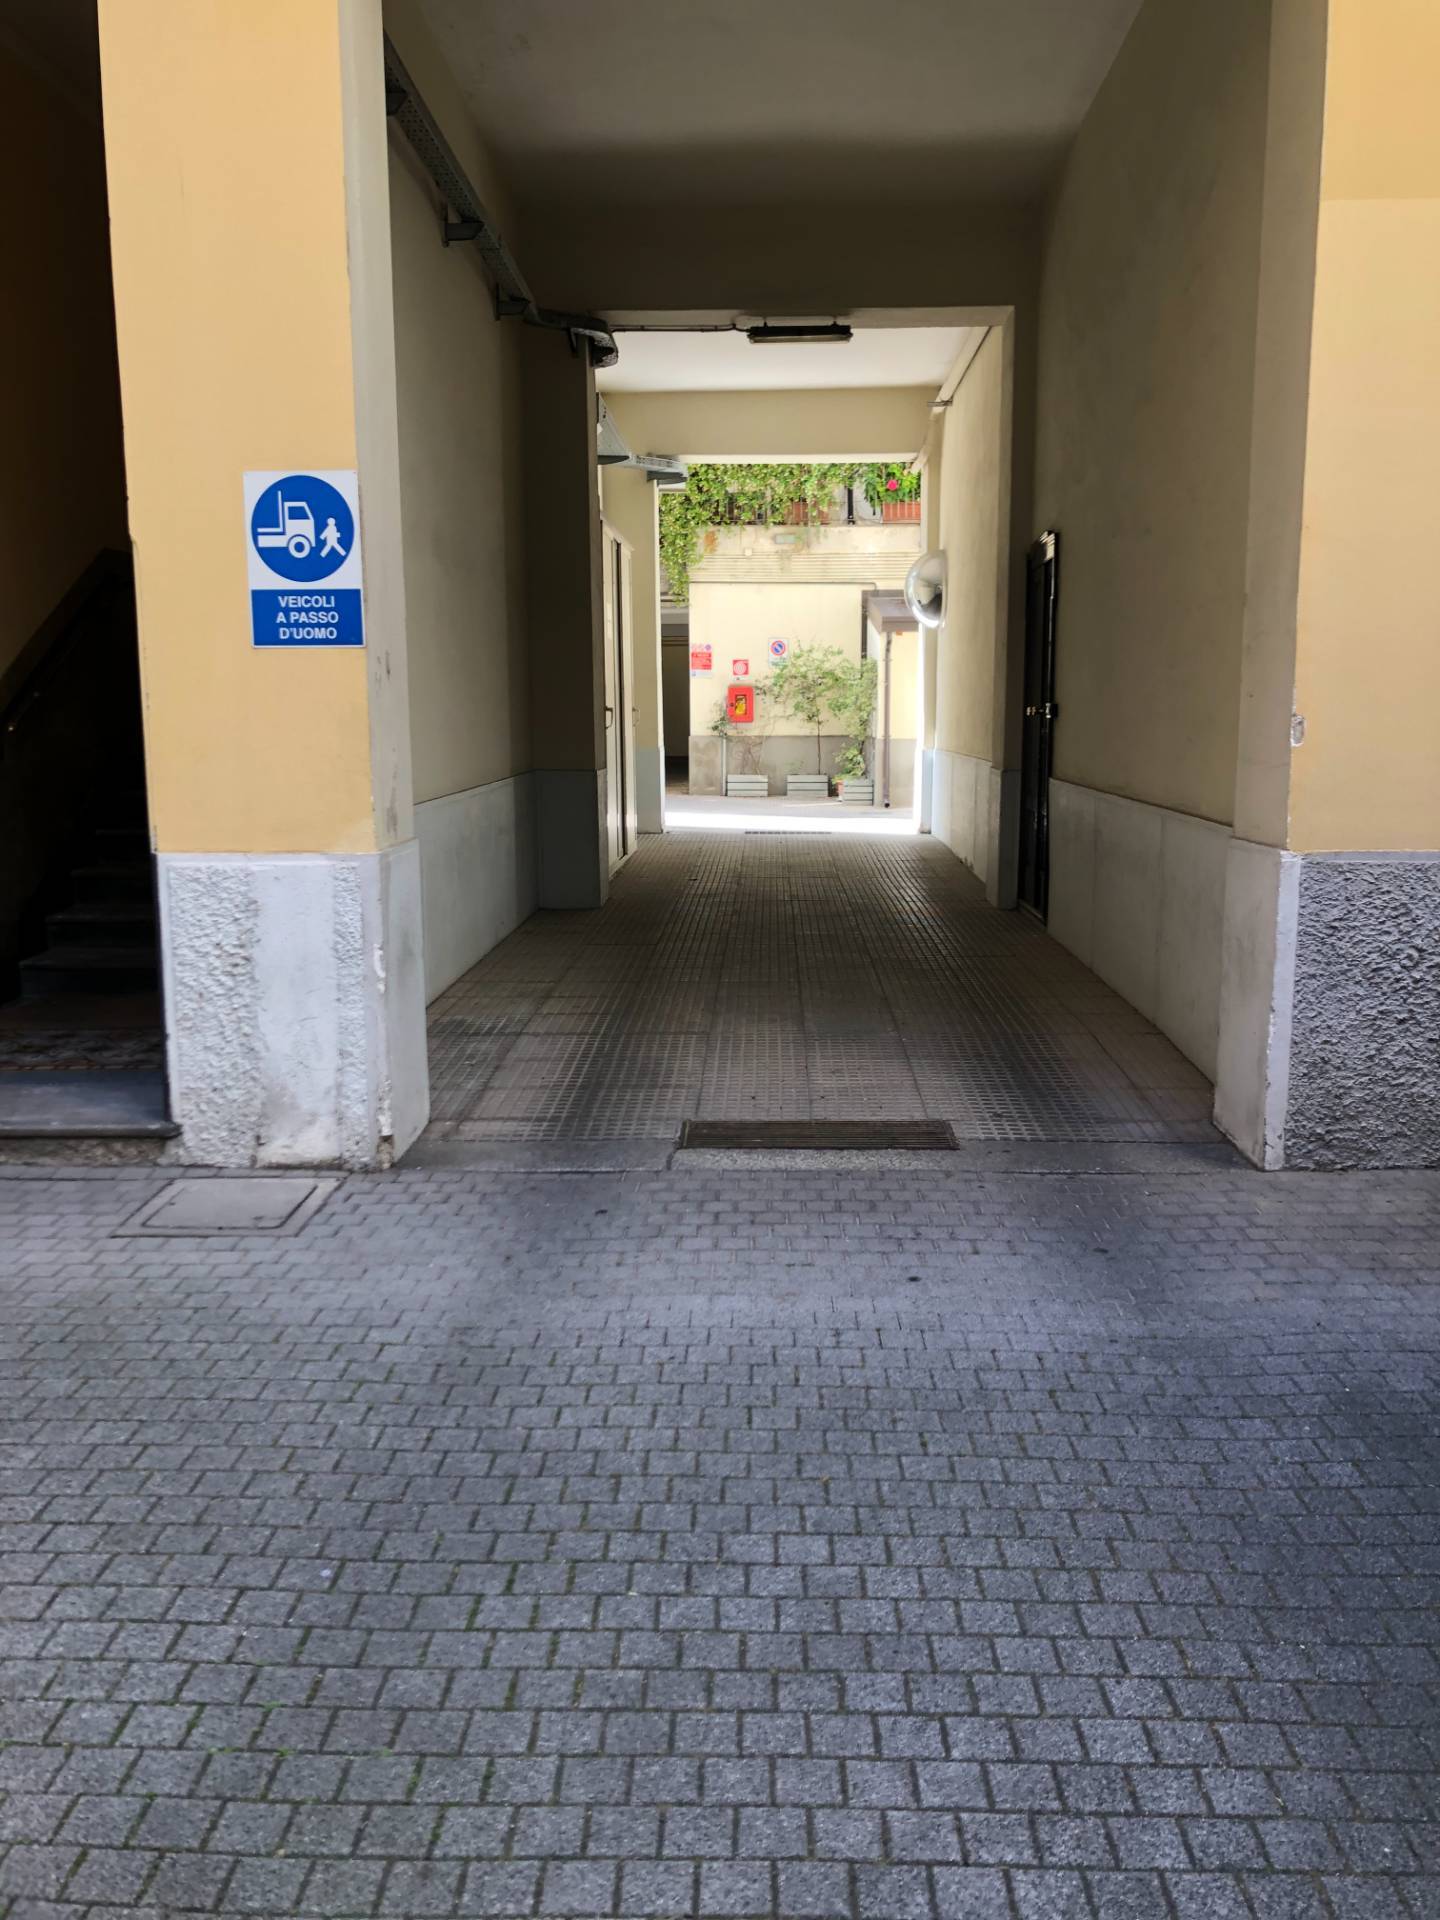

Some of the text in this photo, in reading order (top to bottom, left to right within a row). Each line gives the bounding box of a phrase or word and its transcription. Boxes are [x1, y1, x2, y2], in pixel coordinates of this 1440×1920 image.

[278, 595, 335, 608] VEICOLI
[276, 611, 339, 624] A PASSO
[279, 627, 338, 640] D'UOMO
